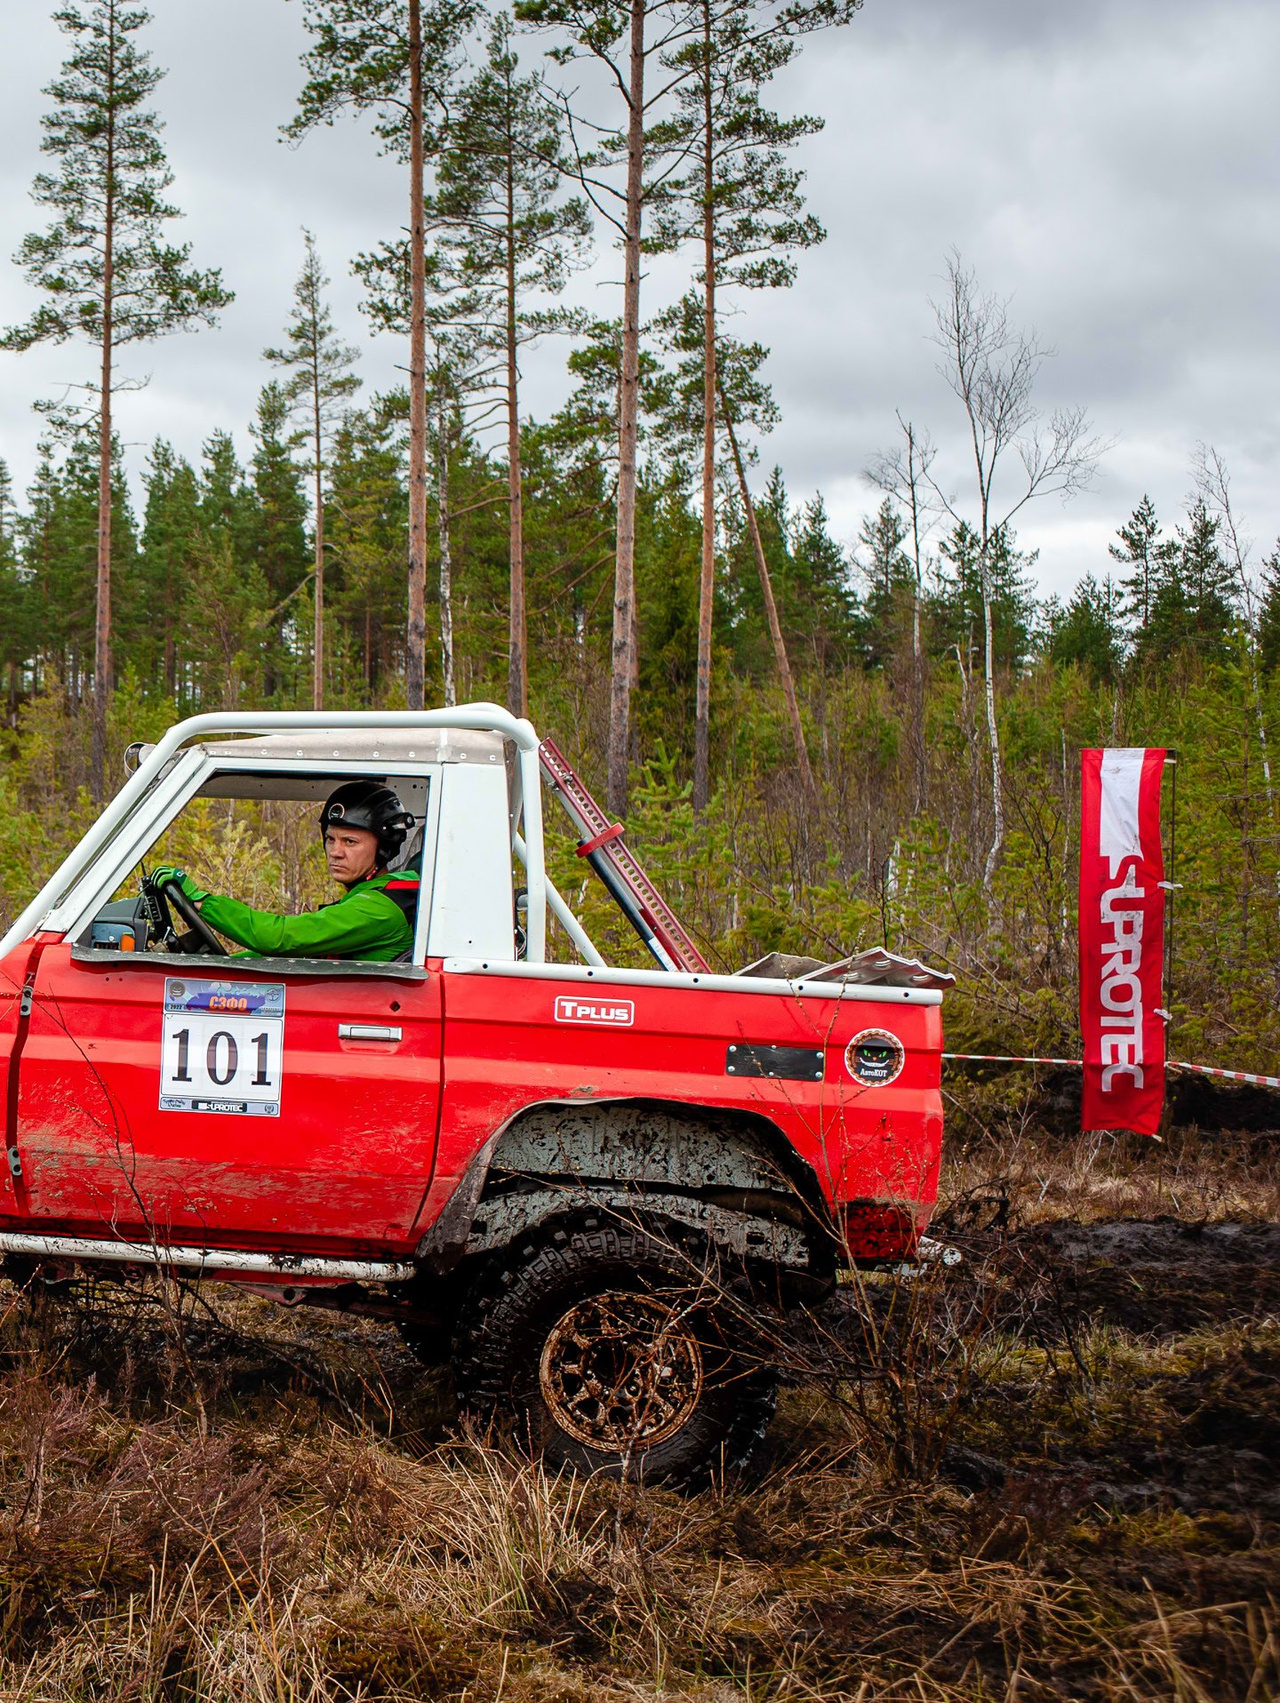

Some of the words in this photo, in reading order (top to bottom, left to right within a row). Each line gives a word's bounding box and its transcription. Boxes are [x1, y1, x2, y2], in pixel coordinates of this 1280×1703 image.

[1100, 855, 1145, 1092] SUPROTEC
[209, 996, 248, 1012] СЗФО
[172, 1028, 272, 1086] 101
[206, 1101, 243, 1112] SUPROTEC
